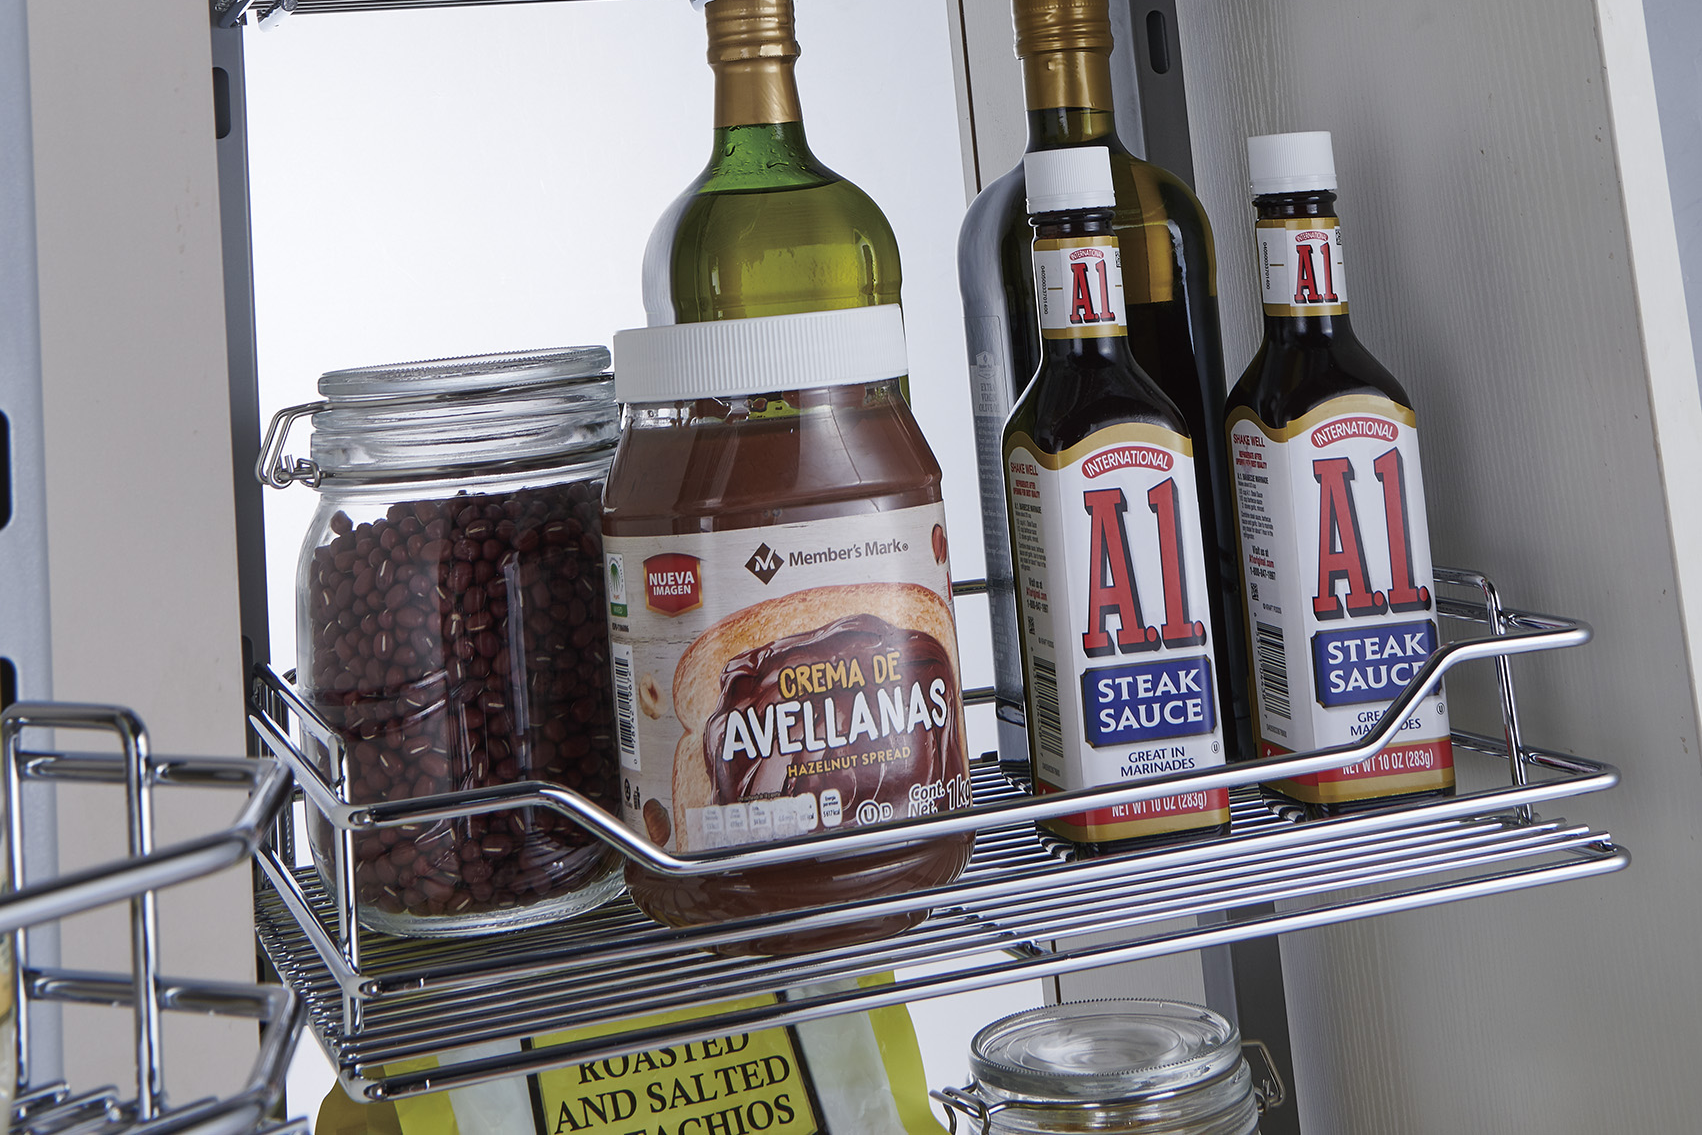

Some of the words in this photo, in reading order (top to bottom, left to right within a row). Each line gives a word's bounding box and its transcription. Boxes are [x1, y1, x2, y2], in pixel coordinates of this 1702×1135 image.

[1233, 433, 1250, 446] SHAKE
[1251, 435, 1266, 448] WELL
[1313, 420, 1394, 447] INTERNATIONAL
[1010, 462, 1025, 474] SHAKE
[1026, 463, 1039, 476] WELL
[1083, 449, 1169, 477] INTERNATIONAL
[1312, 446, 1432, 621] A.1.
[789, 544, 862, 568] Member's
[1082, 476, 1207, 658] A.1.
[649, 571, 695, 586] NUEVA
[653, 585, 692, 596] IMAGEN
[1328, 632, 1427, 665] STEAK
[779, 657, 866, 700] CREMA
[872, 651, 902, 685] DE
[1098, 668, 1202, 704] STEAK
[721, 677, 948, 762] AVELLANAS
[1100, 698, 1204, 733] SAUCE
[787, 754, 858, 778] HAZELNUT
[862, 746, 912, 766] SPREAD
[1120, 757, 1195, 777] MARINADES
[1128, 748, 1168, 764] GREAT
[1171, 746, 1186, 758] IN
[1363, 759, 1377, 774] WT
[1378, 755, 1390, 771] 10
[1391, 753, 1404, 769] OZ
[1405, 748, 1434, 768] (283g)
[908, 779, 946, 802] Cont.
[1178, 791, 1208, 809] (283g)
[554, 1088, 638, 1135] AND
[646, 1054, 790, 1114] SALTED
